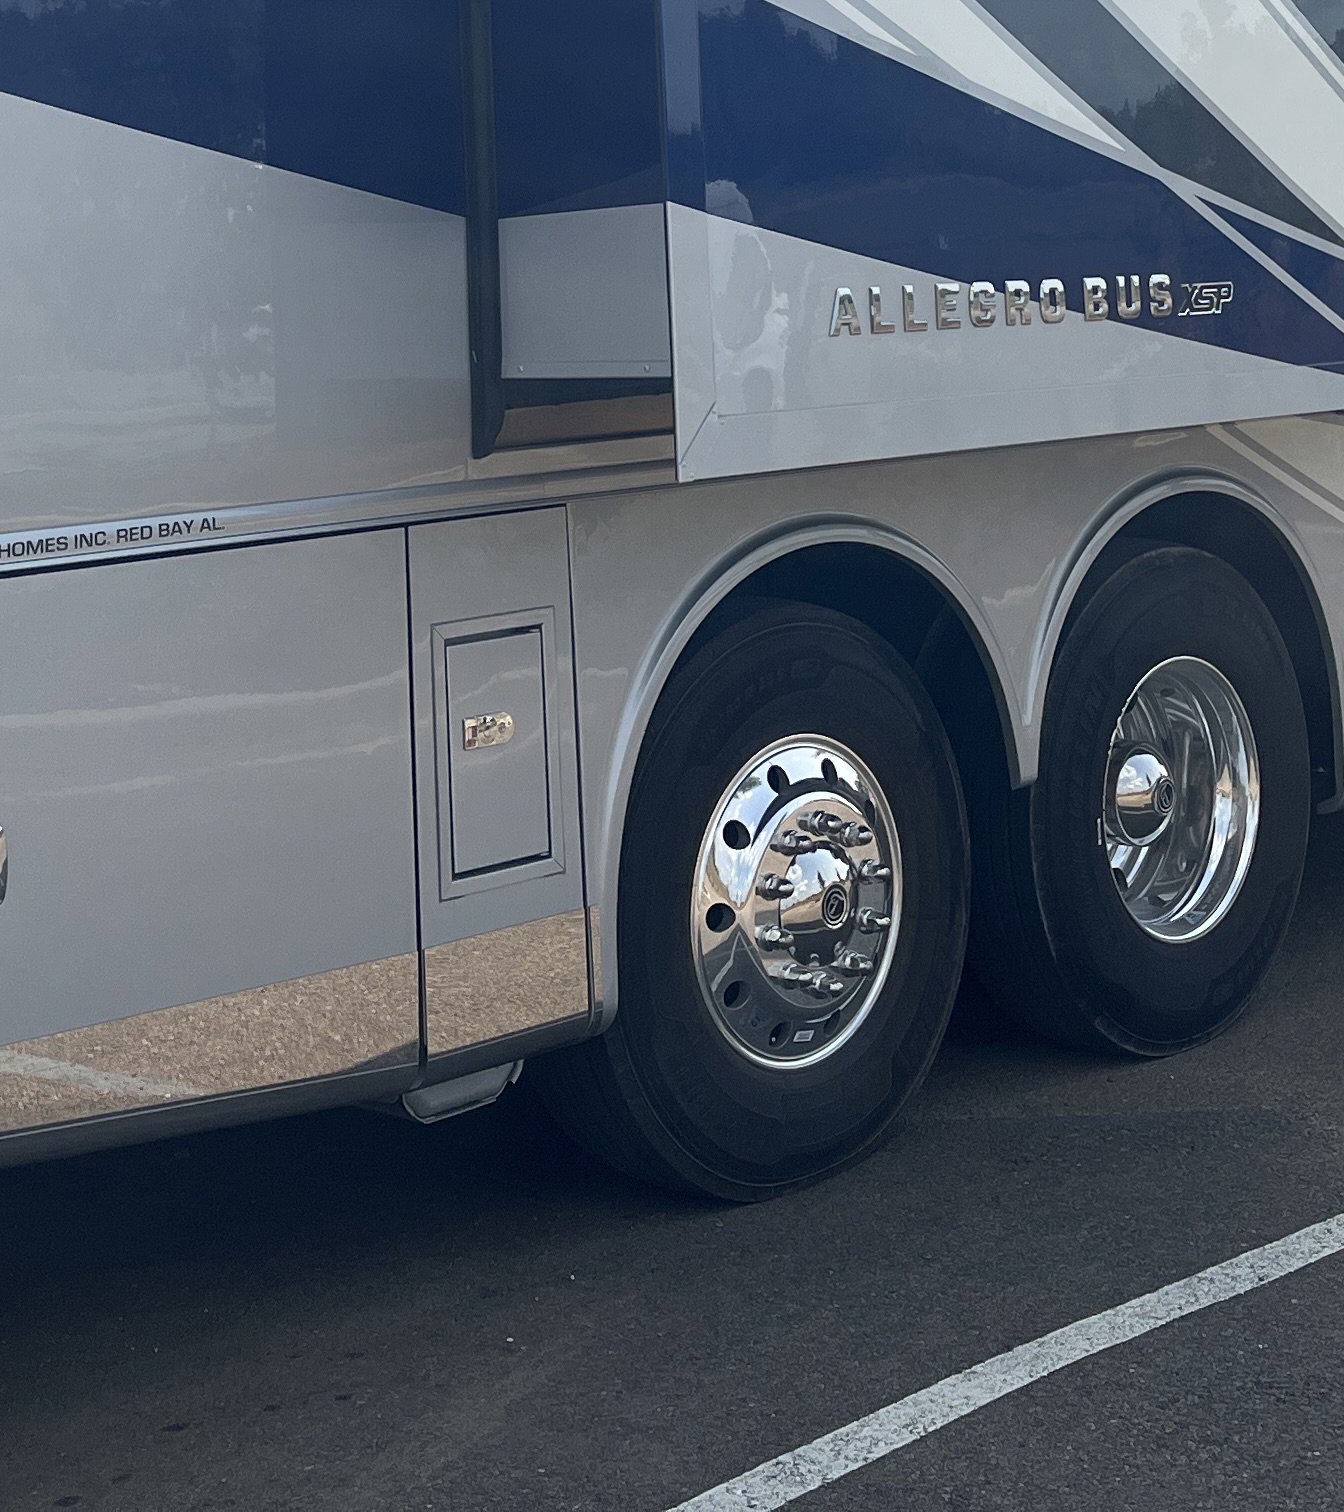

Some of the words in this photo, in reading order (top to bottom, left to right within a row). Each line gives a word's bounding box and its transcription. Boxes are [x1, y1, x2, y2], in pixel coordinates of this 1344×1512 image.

[828, 279, 1067, 338] ALLEGRO
[1083, 273, 1173, 322] BUS
[1178, 281, 1234, 317] XSP
[116, 524, 153, 543] RED
[158, 519, 195, 538] BAY
